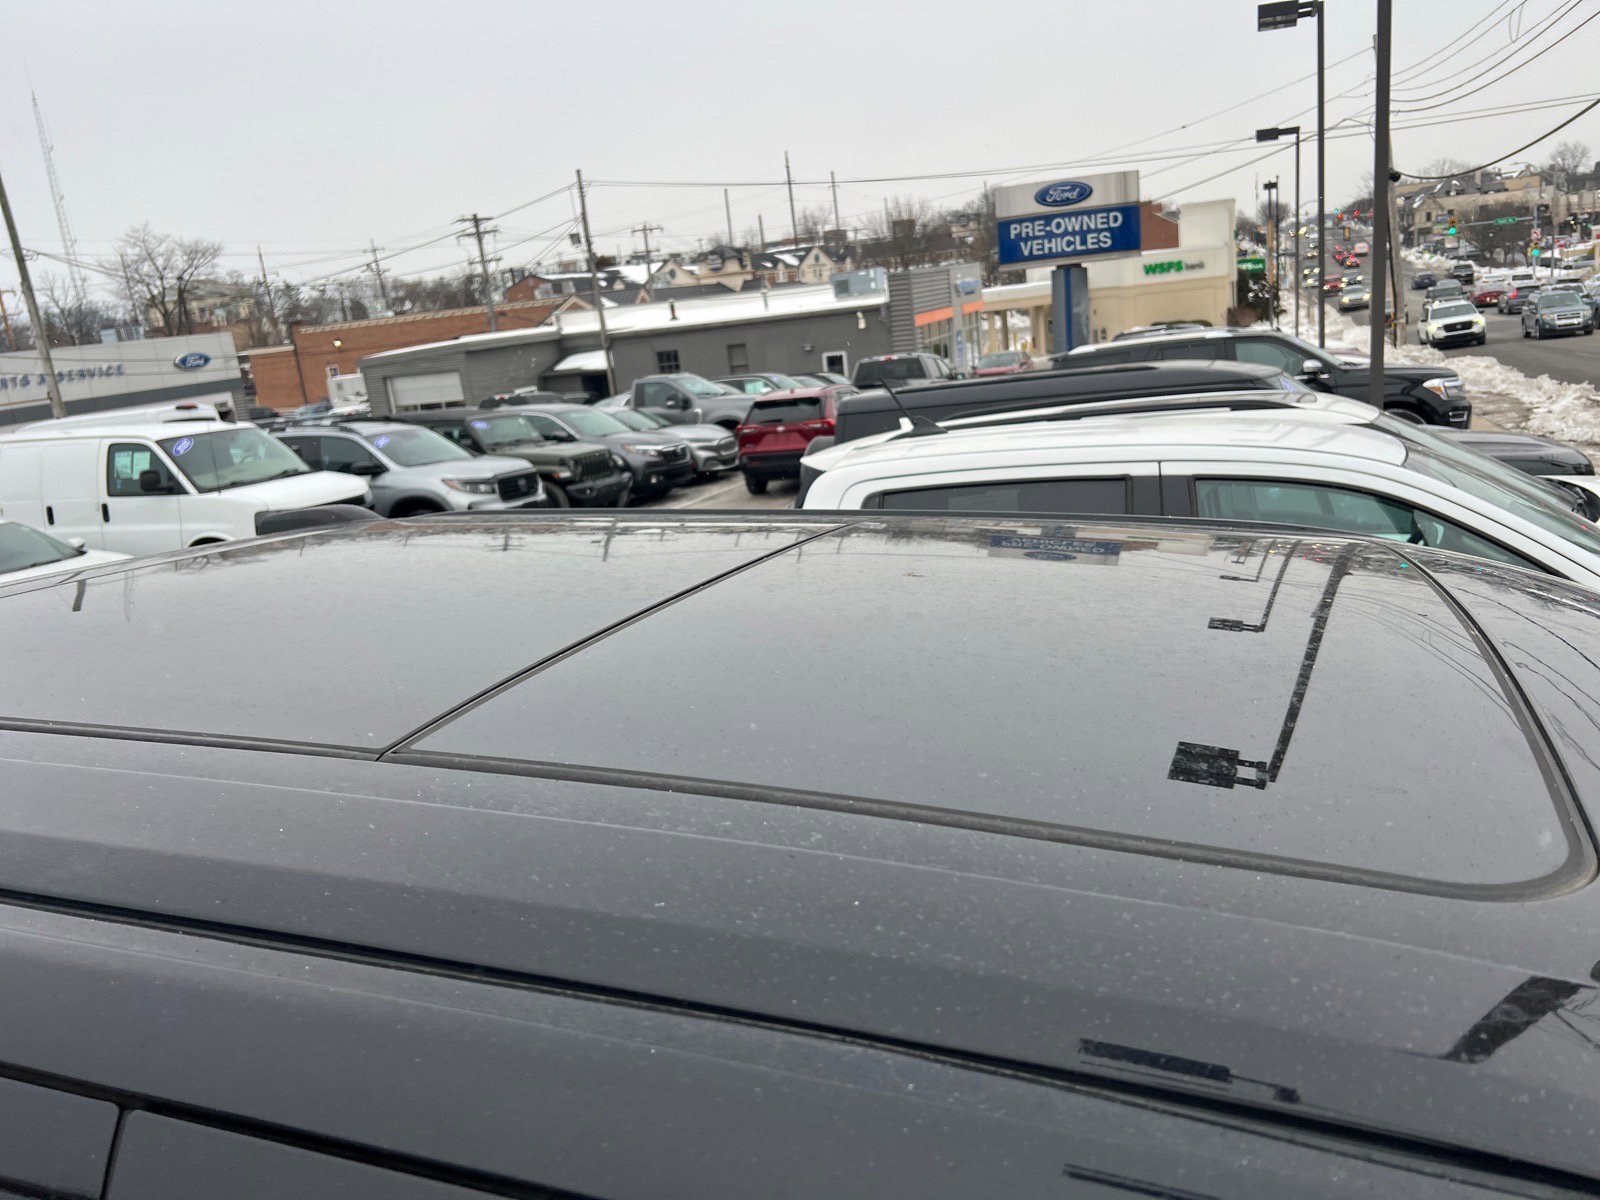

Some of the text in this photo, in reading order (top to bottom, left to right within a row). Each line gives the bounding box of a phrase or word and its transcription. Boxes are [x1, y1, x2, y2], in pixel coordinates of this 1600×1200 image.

[1045, 185, 1081, 202] Ford
[1009, 211, 1123, 239] PRE-OWNED
[1020, 232, 1112, 256] VEHICLES
[1143, 260, 1184, 275] WSFS
[57, 364, 124, 384] SERVICE
